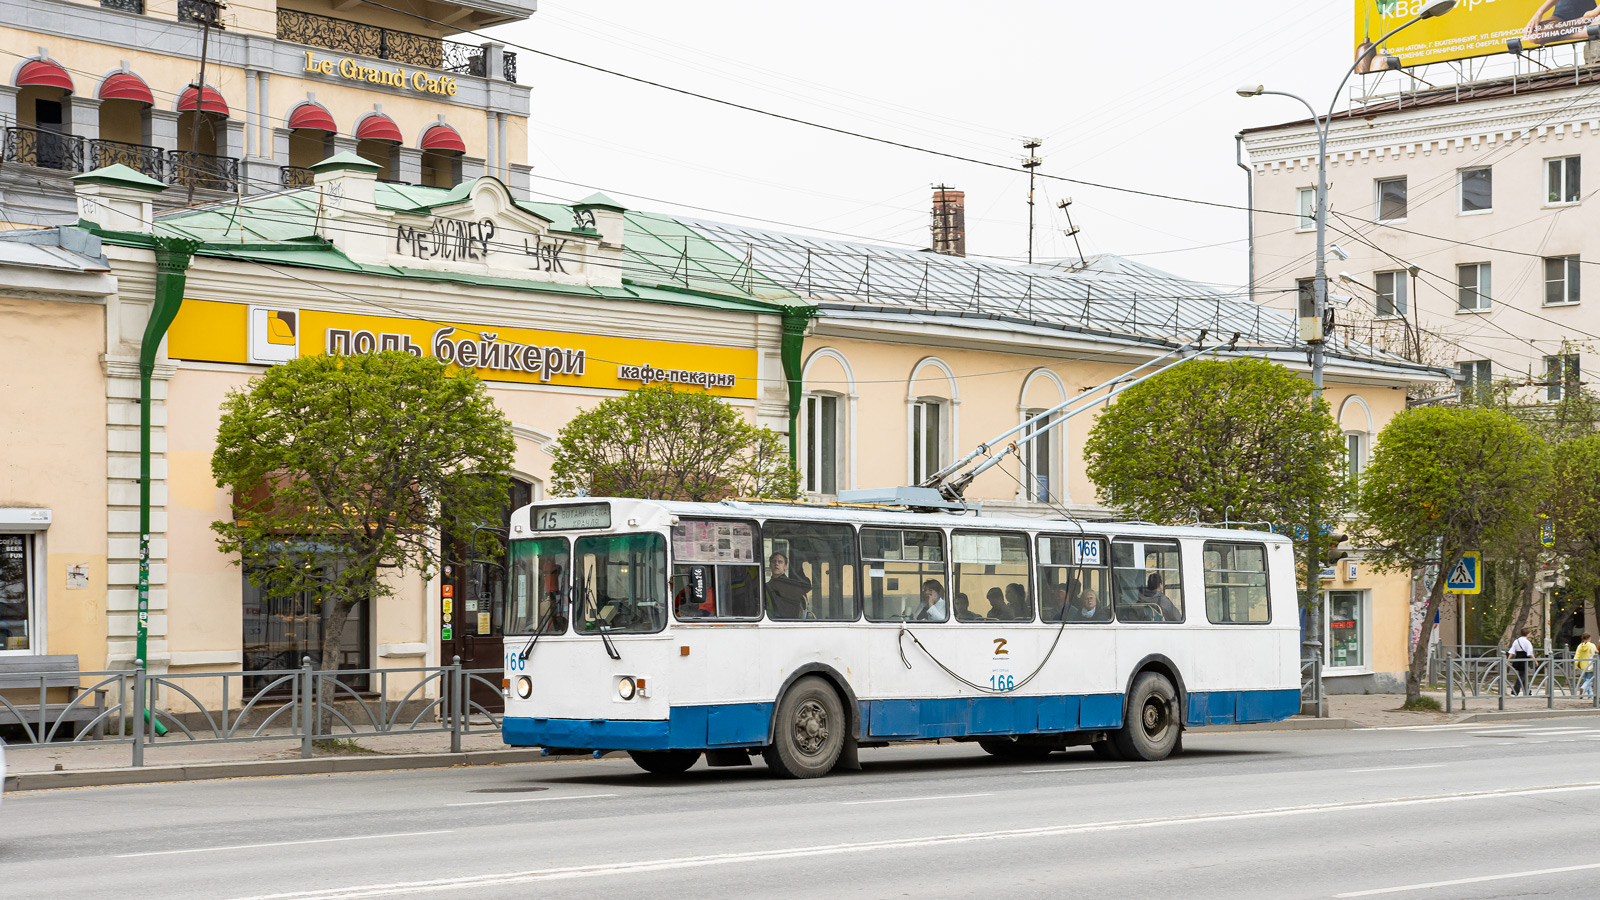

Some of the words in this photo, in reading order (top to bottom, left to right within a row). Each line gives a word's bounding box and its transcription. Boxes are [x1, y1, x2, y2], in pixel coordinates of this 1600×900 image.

[1560, 26, 1583, 35] САЙТЕ
[304, 51, 333, 75] Le
[338, 57, 406, 88] Grand
[411, 70, 458, 96] Café
[432, 327, 586, 382] бейкери
[617, 363, 736, 389] кафе-пекарня
[541, 512, 557, 529] 15
[1077, 541, 1097, 556] 166
[505, 652, 525, 671] 166
[989, 674, 1014, 691] 166
